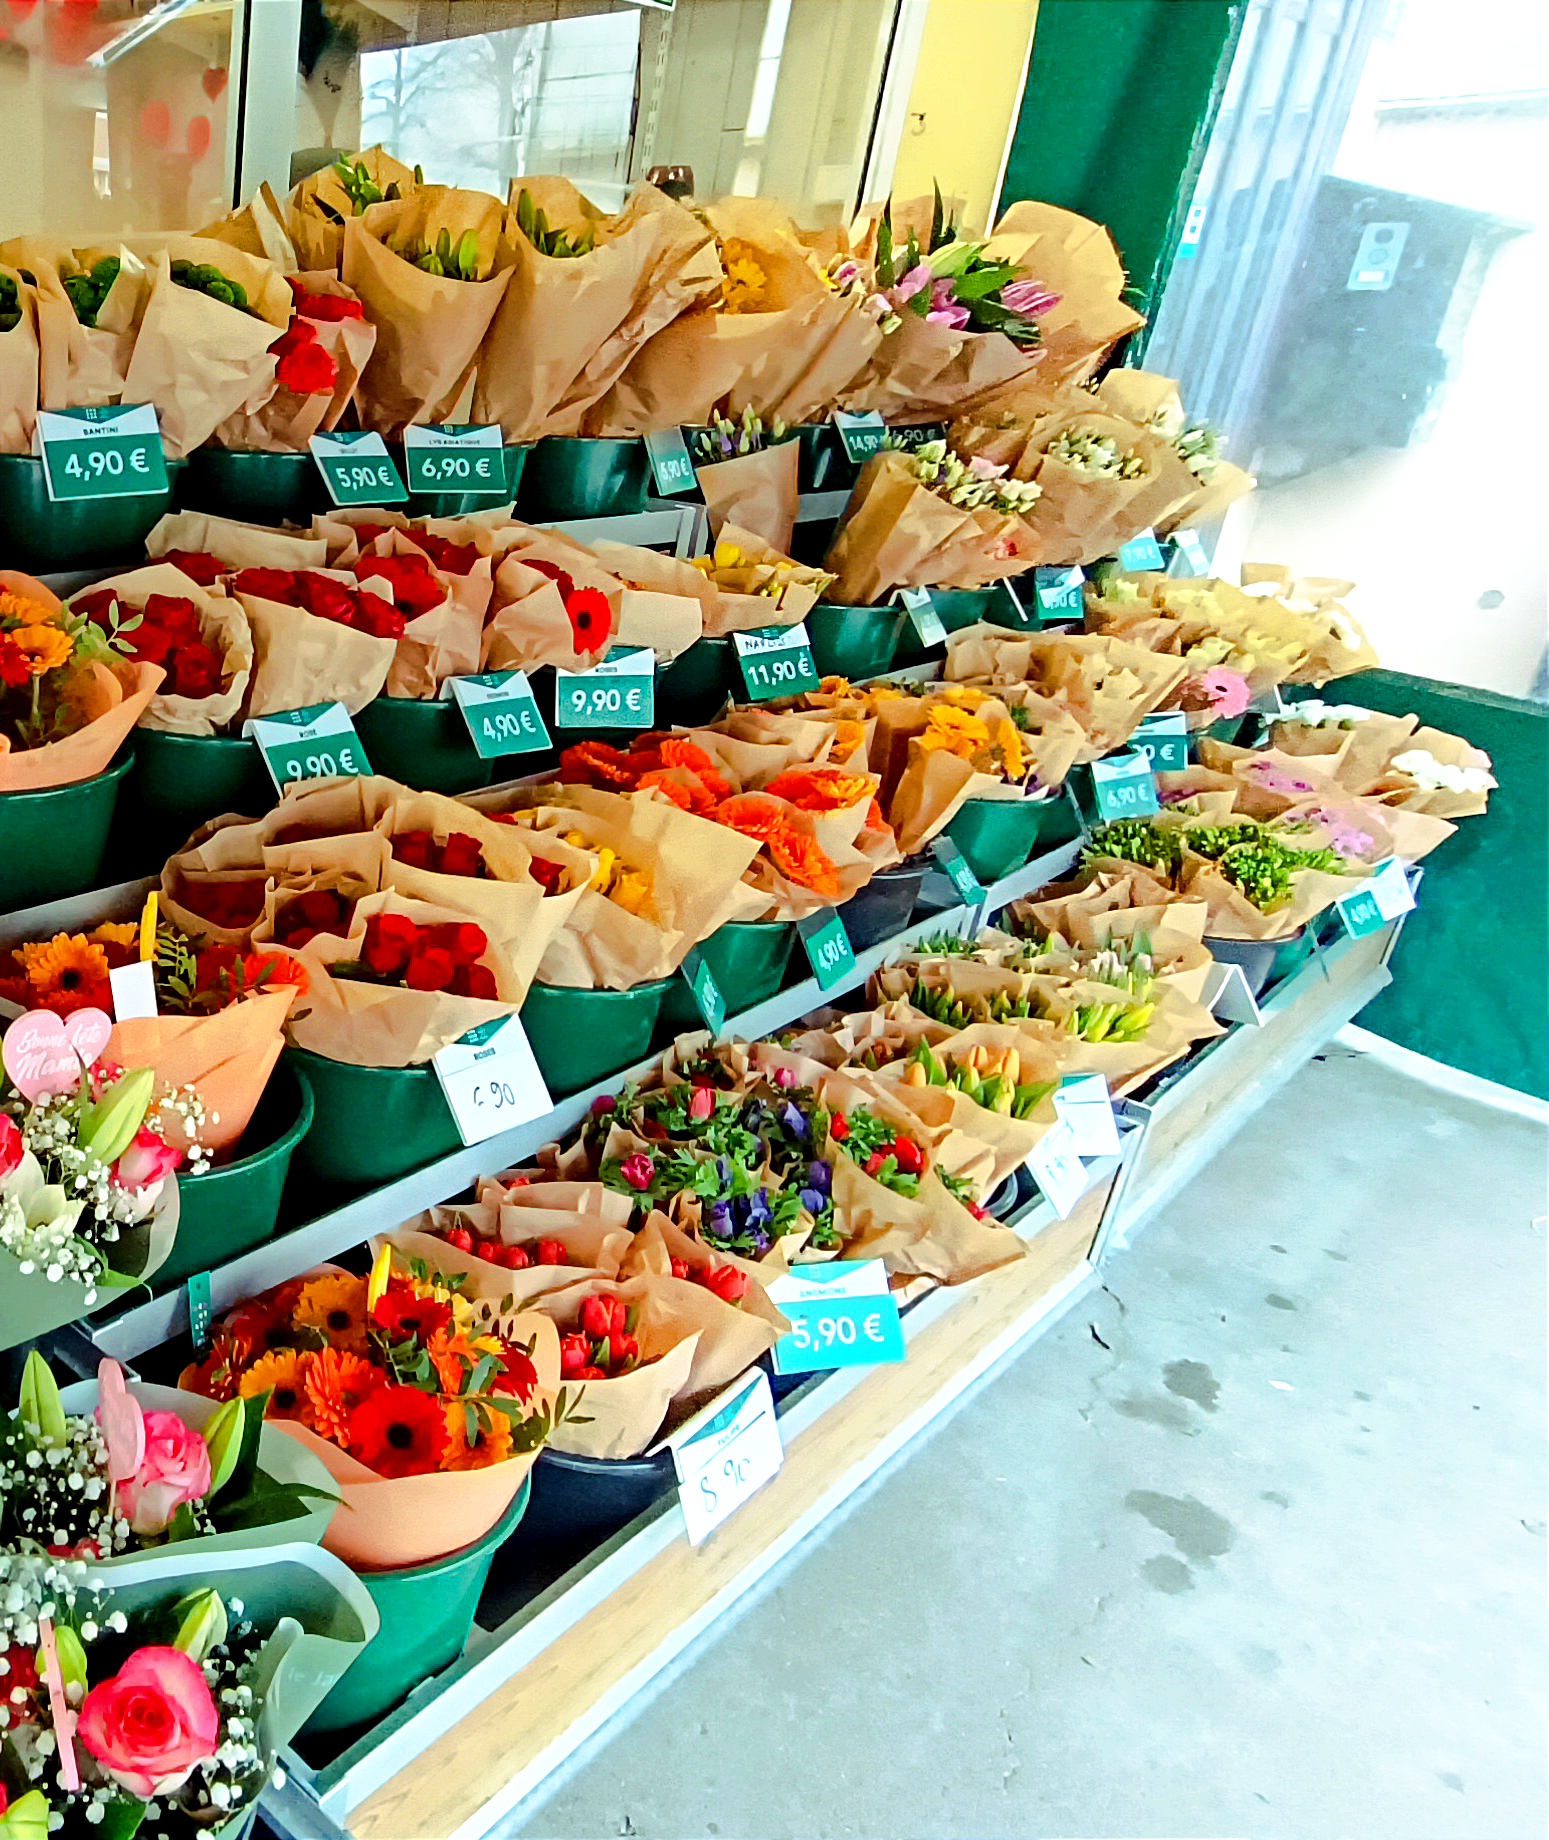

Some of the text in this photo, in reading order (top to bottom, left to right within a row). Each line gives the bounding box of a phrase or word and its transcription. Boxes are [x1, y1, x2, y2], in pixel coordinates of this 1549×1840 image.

[64, 447, 150, 481] 4,90 €
[421, 457, 492, 480] 6,90 €
[335, 466, 394, 490] 5,90 €
[748, 660, 797, 686] 11,90
[572, 687, 642, 715] 9,90 €
[483, 709, 537, 743] 4,90 €
[339, 748, 359, 774] €
[1159, 743, 1175, 761] €
[1106, 786, 1136, 808] 6,90
[16, 1028, 67, 1053] Bonne
[791, 1313, 885, 1352] 5,90 €
